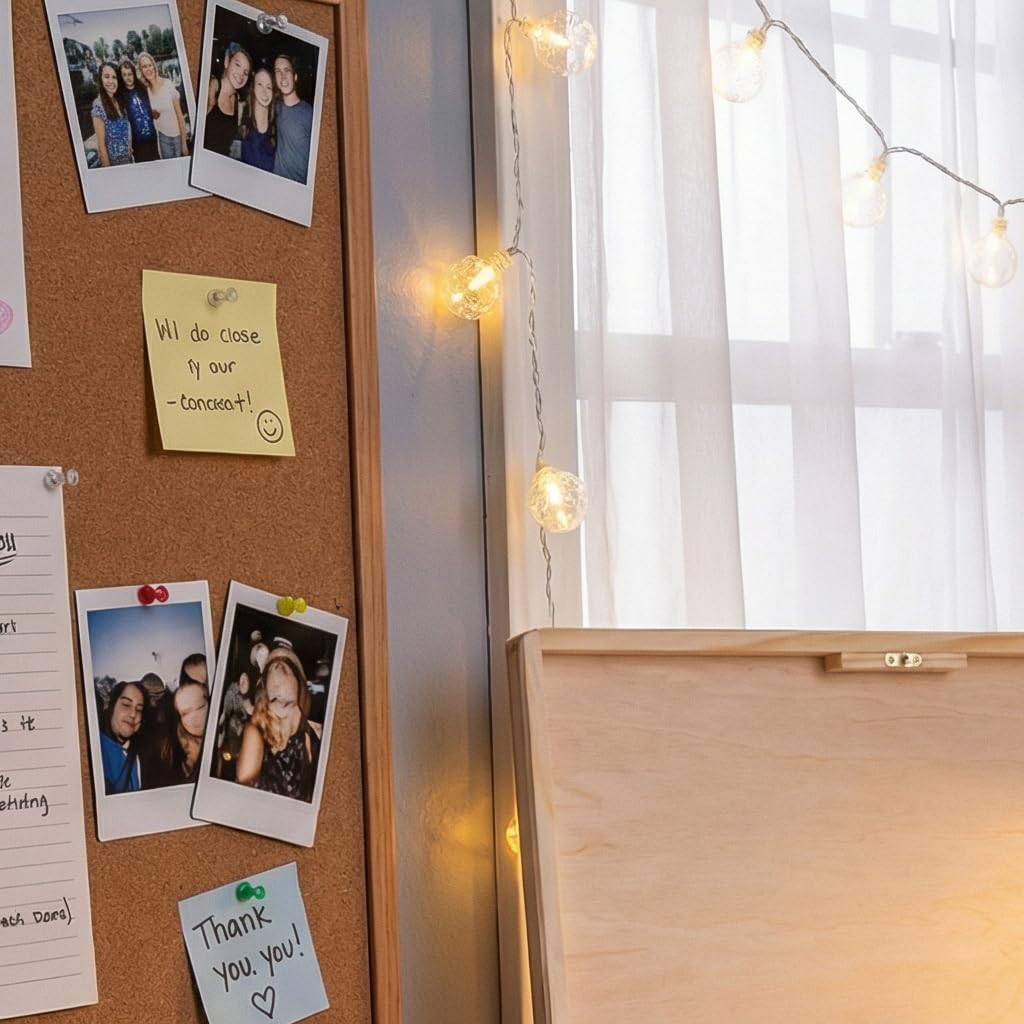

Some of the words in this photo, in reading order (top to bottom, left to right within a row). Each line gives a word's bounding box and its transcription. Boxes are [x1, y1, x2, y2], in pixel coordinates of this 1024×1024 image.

[190, 322, 210, 342] do
[220, 327, 262, 344] close
[208, 361, 237, 374] our
[192, 905, 272, 950] Thank
